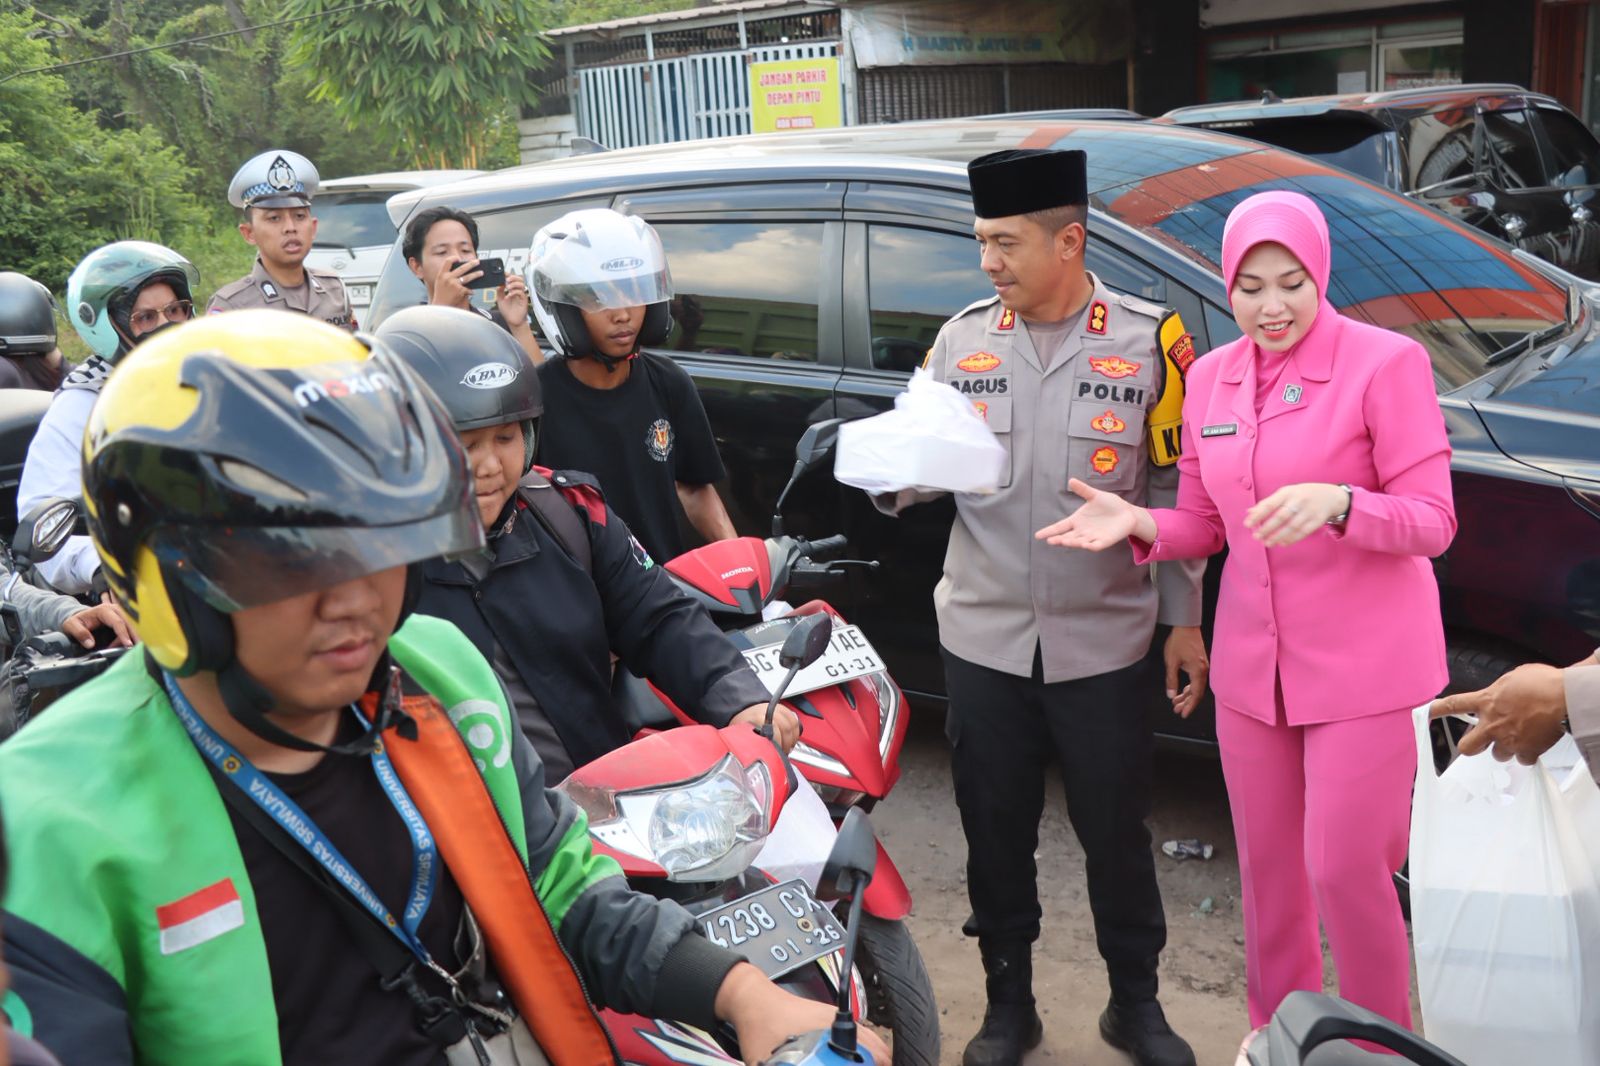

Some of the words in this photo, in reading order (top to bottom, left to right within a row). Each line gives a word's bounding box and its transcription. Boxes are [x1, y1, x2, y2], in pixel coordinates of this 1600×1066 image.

[760, 71, 793, 87] JANGAN
[796, 68, 827, 83] PARKIR
[767, 91, 793, 106] DEPAN
[797, 89, 821, 104] PINTU
[1079, 382, 1143, 404] POLRI
[721, 566, 754, 580] HONDA
[250, 778, 315, 845] SRIWIJAYA
[313, 841, 384, 916] UNIVERSITAS
[376, 759, 431, 850] UNIVERSITAS
[406, 852, 432, 920] SRIWIJAYA
[778, 885, 822, 918] CX
